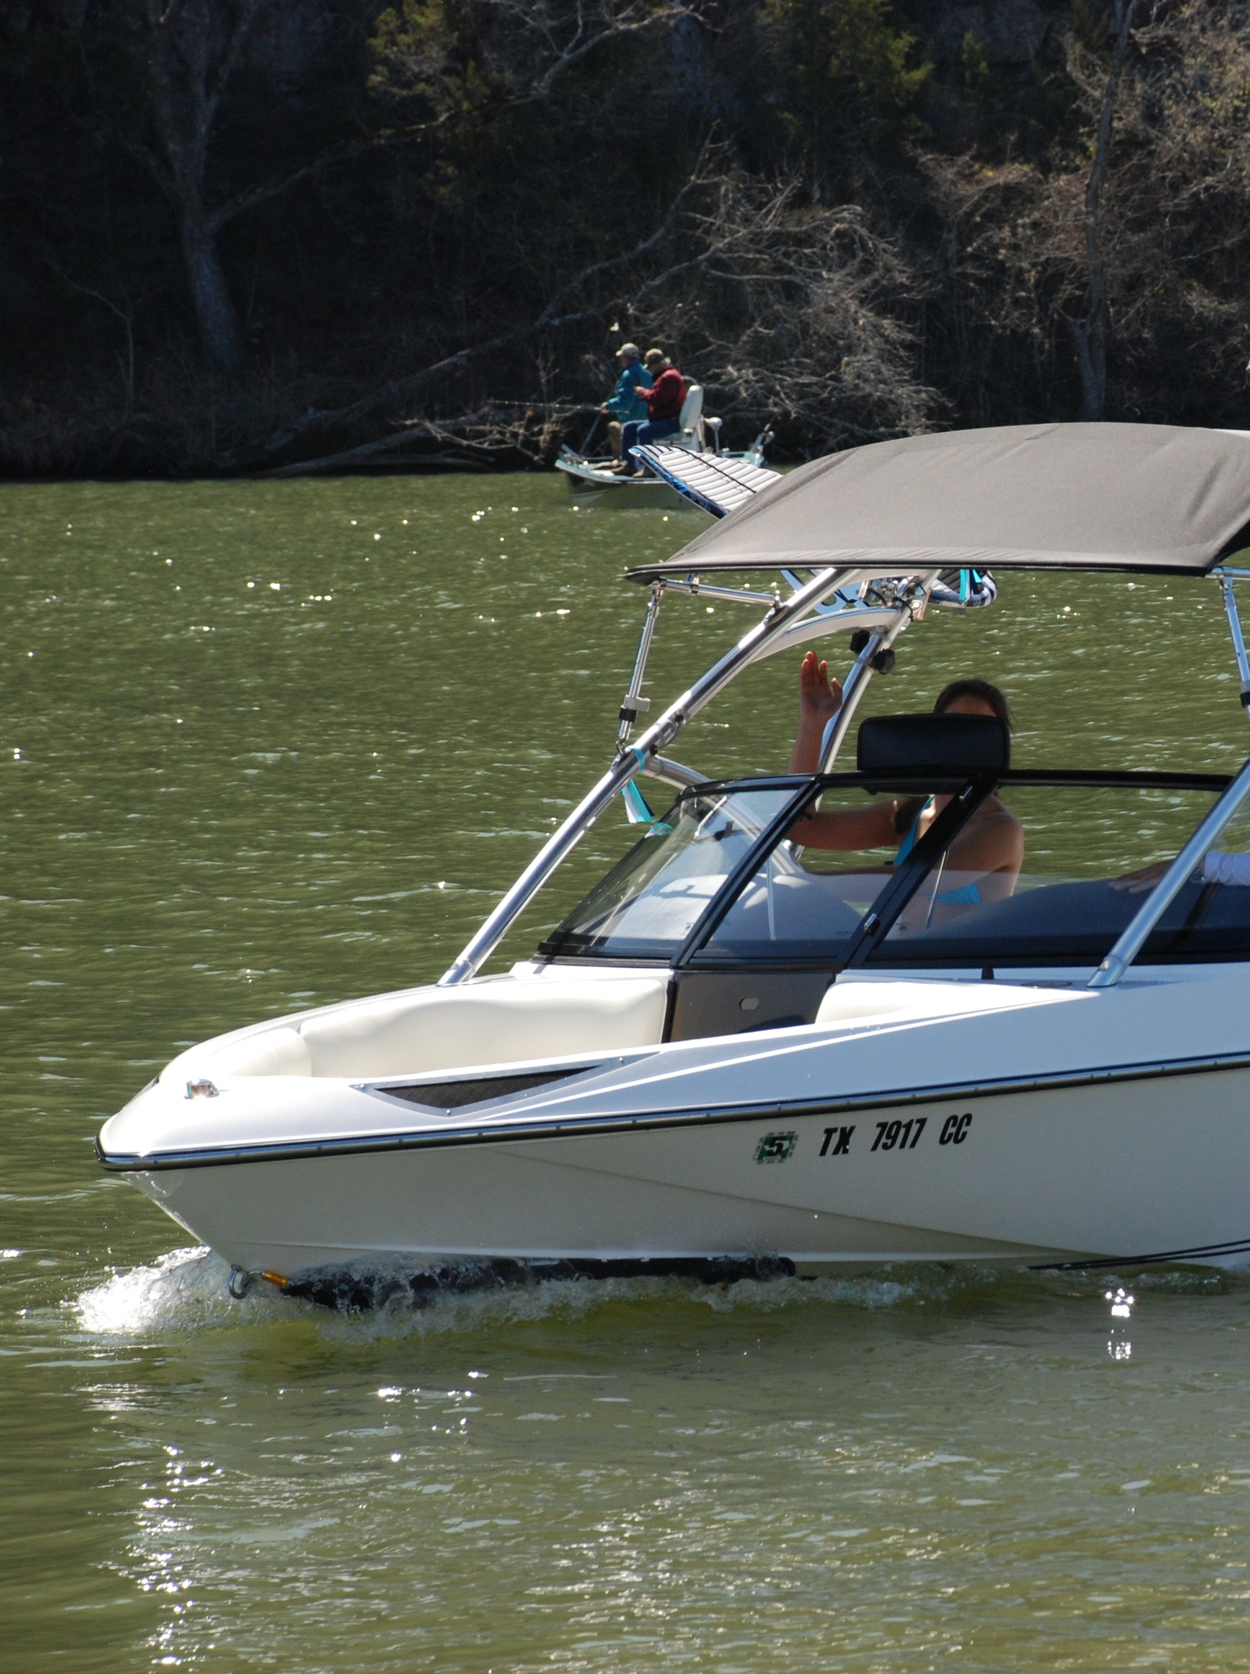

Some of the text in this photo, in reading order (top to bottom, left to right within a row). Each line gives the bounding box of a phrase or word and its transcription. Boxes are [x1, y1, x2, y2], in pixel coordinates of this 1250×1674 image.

[819, 1113, 973, 1157] TX 7917 CC
